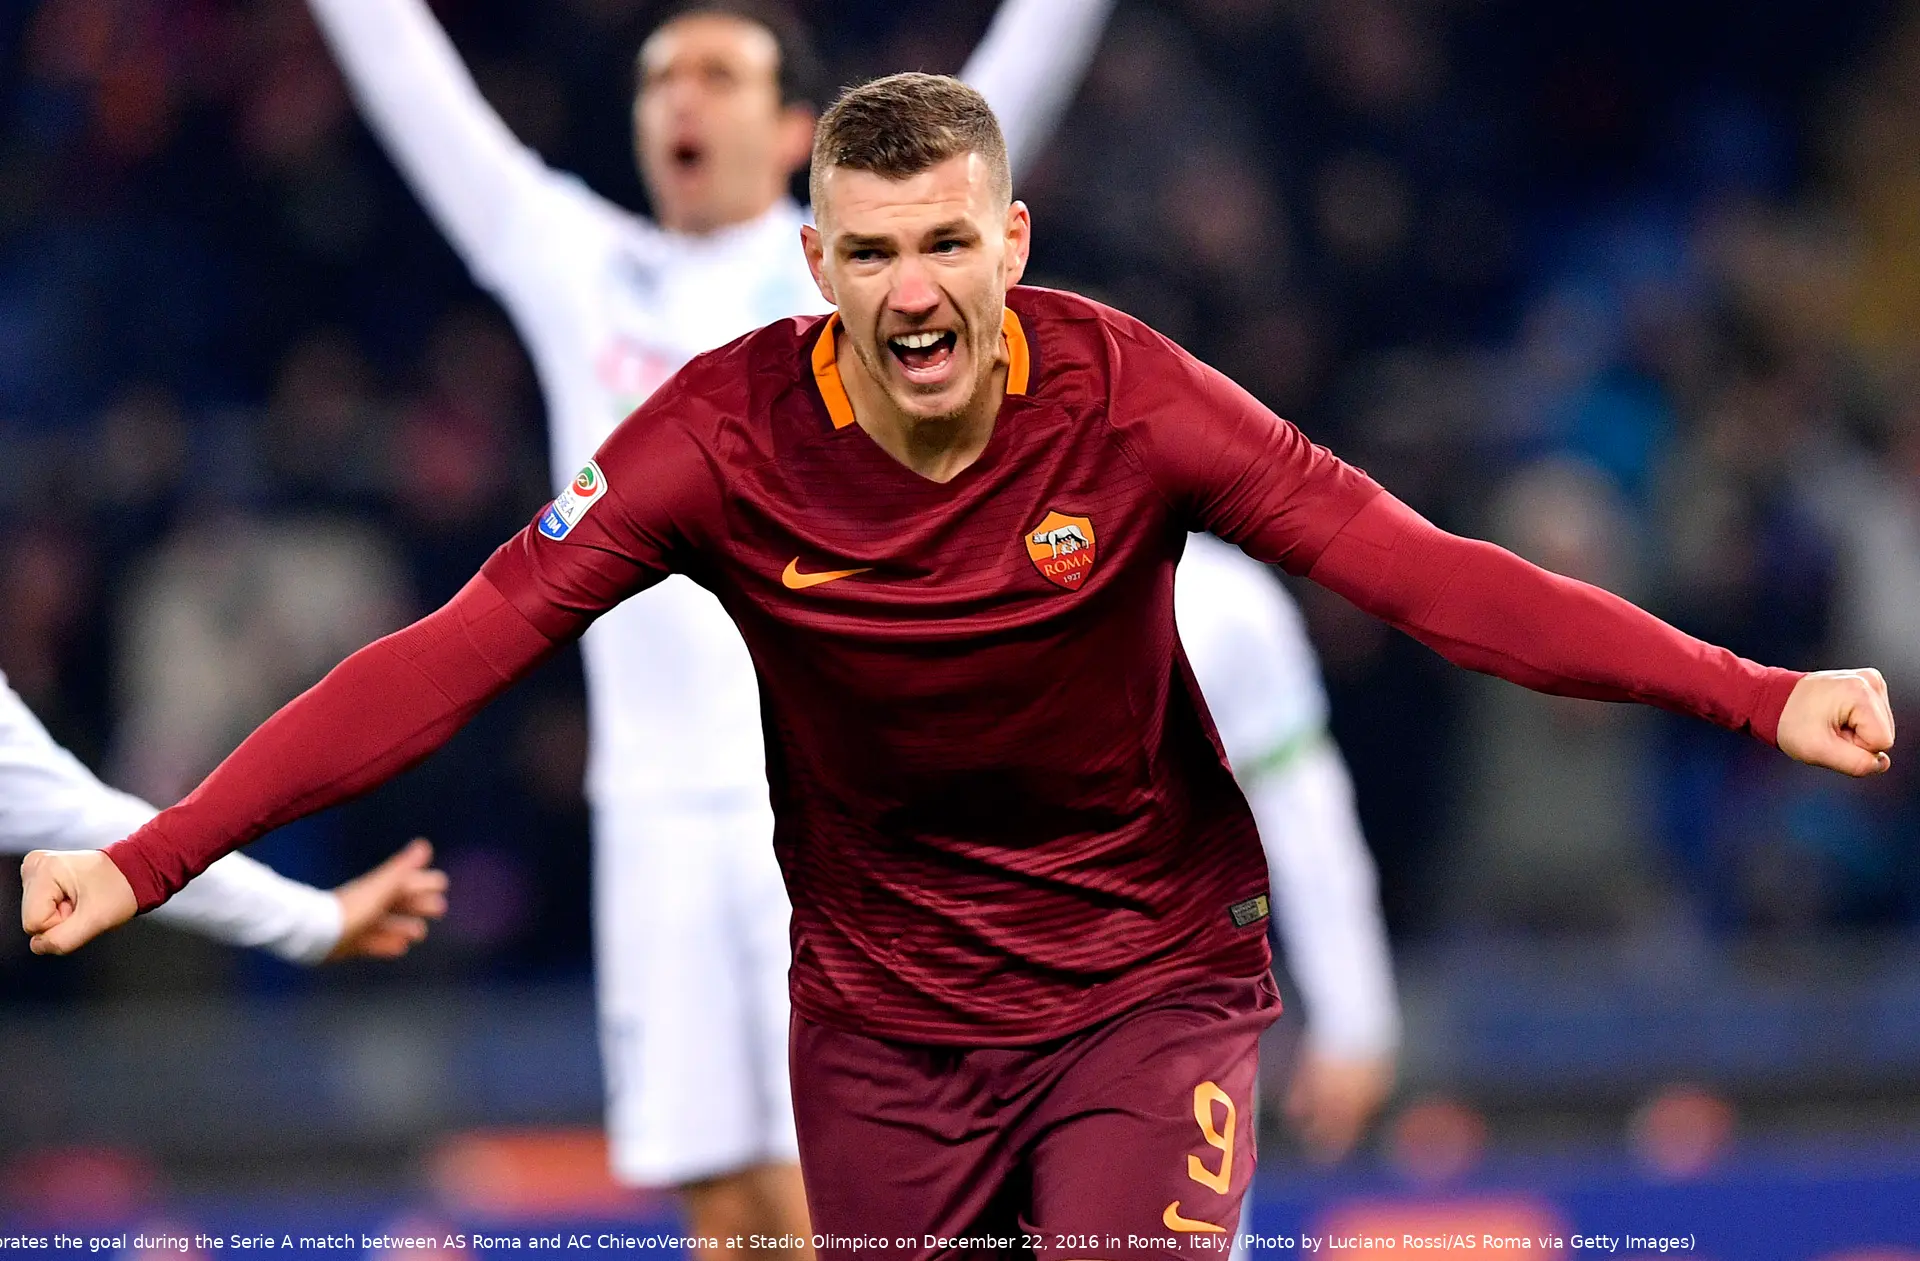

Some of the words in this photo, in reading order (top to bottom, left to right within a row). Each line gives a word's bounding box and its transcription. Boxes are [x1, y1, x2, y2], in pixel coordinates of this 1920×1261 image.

[545, 512, 562, 534] TIM
[1043, 553, 1093, 577] ROMA
[1063, 571, 1081, 583] 1927
[1187, 1080, 1237, 1195] 9
